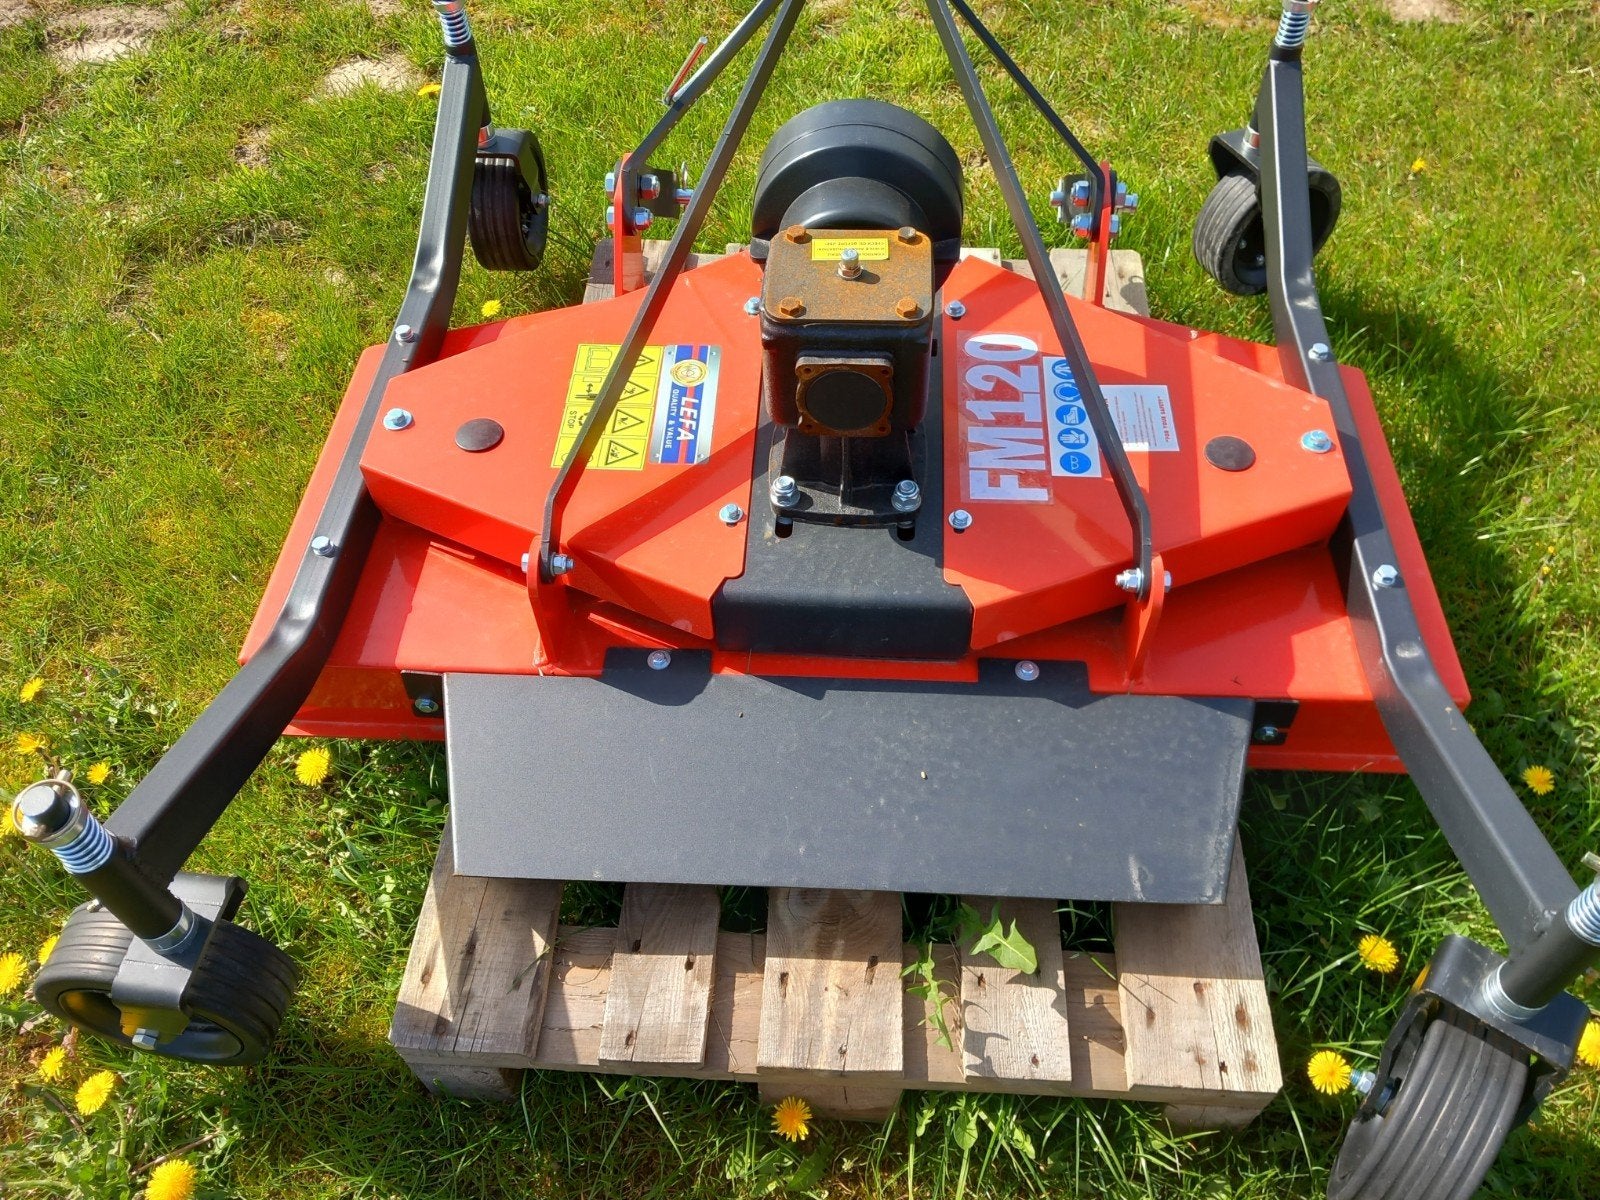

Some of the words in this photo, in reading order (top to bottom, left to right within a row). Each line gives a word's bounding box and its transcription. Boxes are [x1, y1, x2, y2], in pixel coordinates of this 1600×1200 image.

[671, 389, 680, 417] QUALITY
[964, 334, 1048, 500] FM120
[567, 410, 578, 429] STOP
[677, 396, 699, 441] LEFA
[665, 427, 674, 449] VALUE
